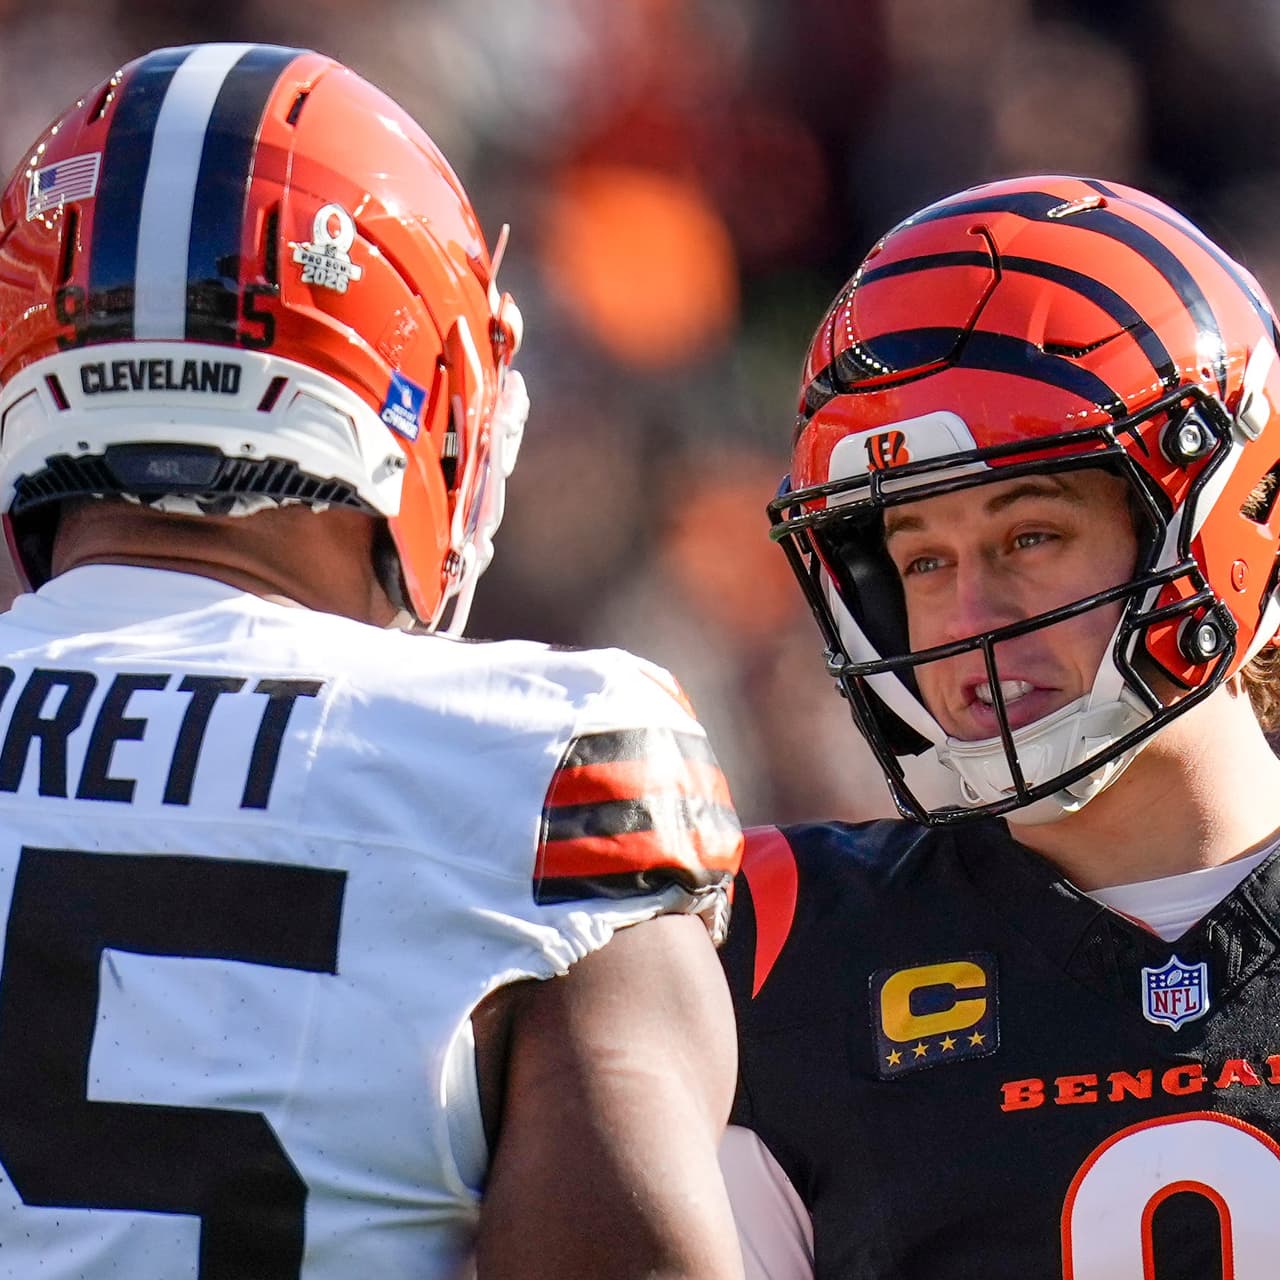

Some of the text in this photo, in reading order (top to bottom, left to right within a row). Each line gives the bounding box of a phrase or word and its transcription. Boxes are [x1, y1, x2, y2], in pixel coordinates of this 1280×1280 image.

[238, 284, 276, 349] 5
[80, 359, 241, 395] CLEVELAND
[881, 961, 987, 1042] C
[1153, 988, 1197, 1015] NFL
